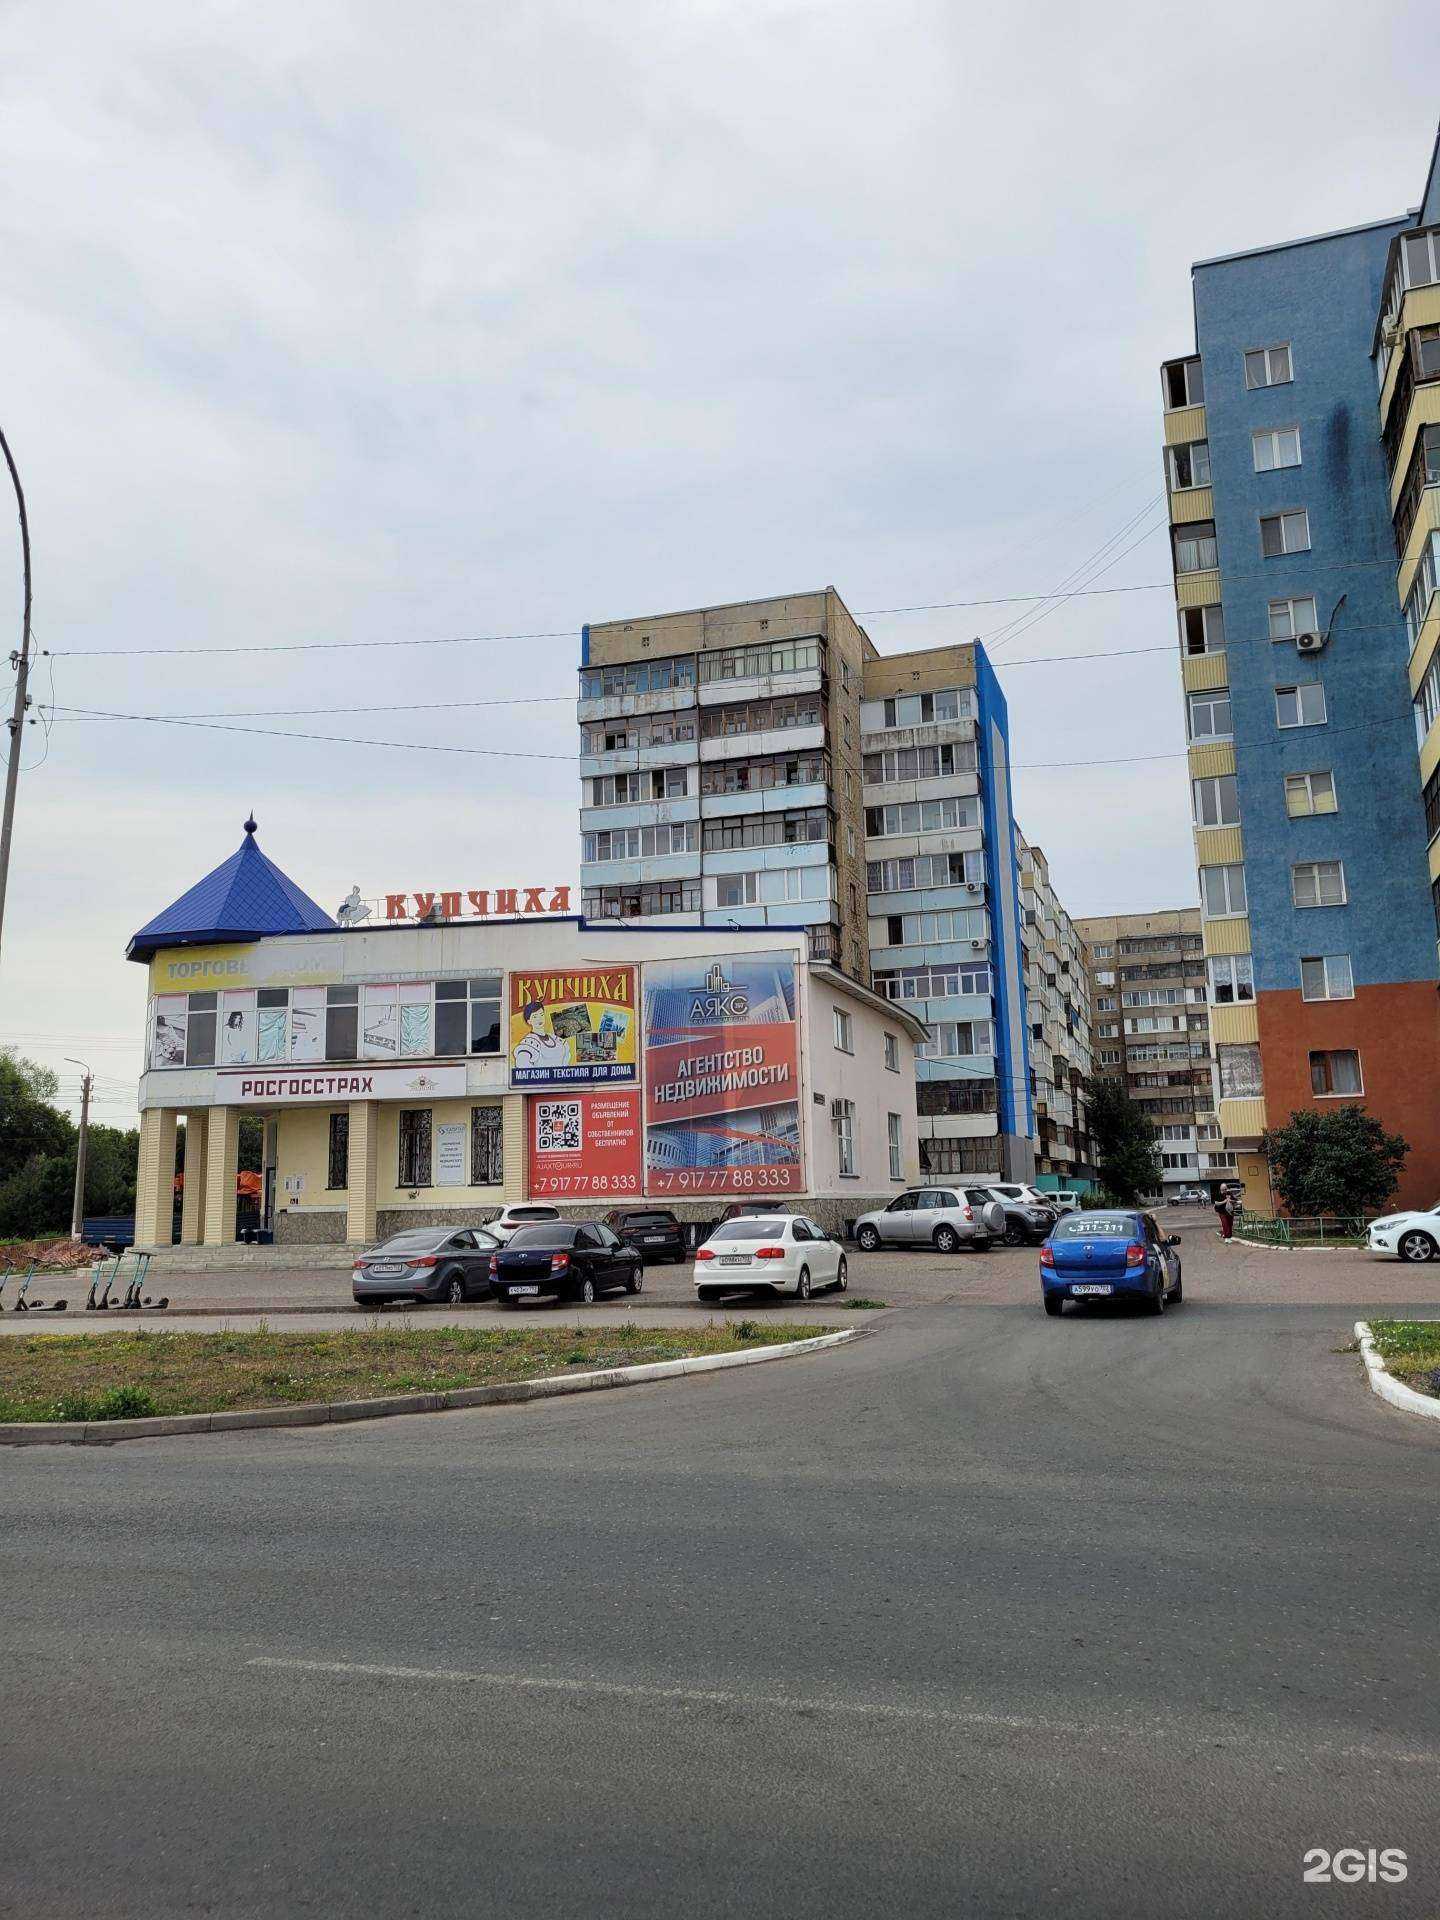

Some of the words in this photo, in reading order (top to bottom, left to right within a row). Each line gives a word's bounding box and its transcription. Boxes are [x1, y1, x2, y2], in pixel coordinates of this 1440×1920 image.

[385, 886, 571, 919] КУПЧИХА
[518, 974, 628, 1008] КУПЧИХА
[690, 995, 748, 1018] АЯКС
[515, 1069, 550, 1080] МАГАЗИН
[553, 1067, 590, 1079] ТЕКСТИЛЯ
[592, 1066, 608, 1077] ДЛЯ
[610, 1064, 632, 1076] ДОМА
[677, 1046, 763, 1078] АГЕНТСТВО
[241, 1077, 373, 1096] РОСГОССТРАХ
[654, 1062, 789, 1104] НЕДВИЖИМОСТИ
[606, 1120, 614, 1128] ОТ
[534, 1178, 547, 1191] +7
[550, 1177, 571, 1191] 917
[573, 1176, 589, 1190] 77
[591, 1175, 608, 1189] 88
[610, 1174, 636, 1189] 333
[657, 1173, 674, 1189] +7
[678, 1171, 705, 1188] 917
[709, 1170, 728, 1187] 77
[732, 1169, 754, 1187] 88
[758, 1168, 790, 1186] 333
